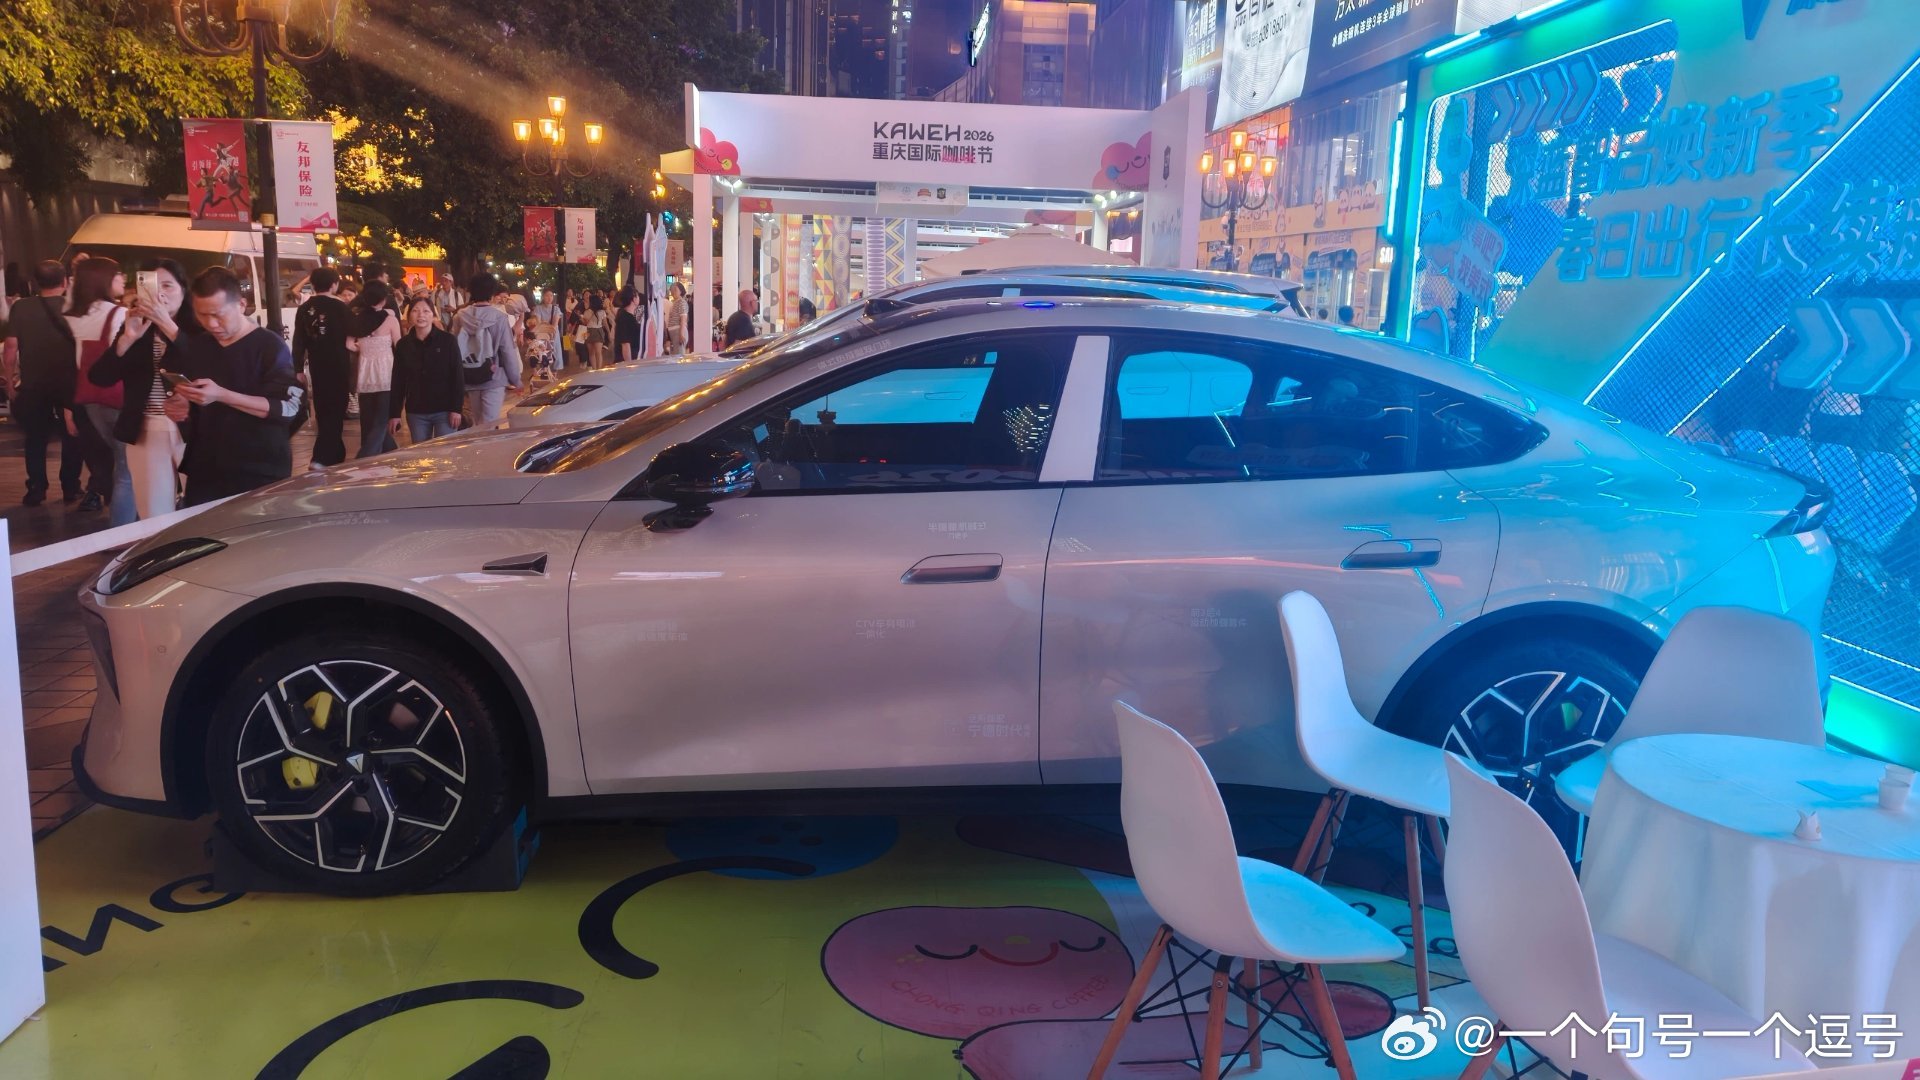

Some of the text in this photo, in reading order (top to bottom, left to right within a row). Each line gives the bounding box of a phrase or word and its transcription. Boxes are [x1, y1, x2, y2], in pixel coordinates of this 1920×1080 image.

[873, 121, 995, 142] KAWEH 2026
[872, 142, 993, 164] 重庆国际咖啡节
[297, 141, 313, 197] 友邦保险
